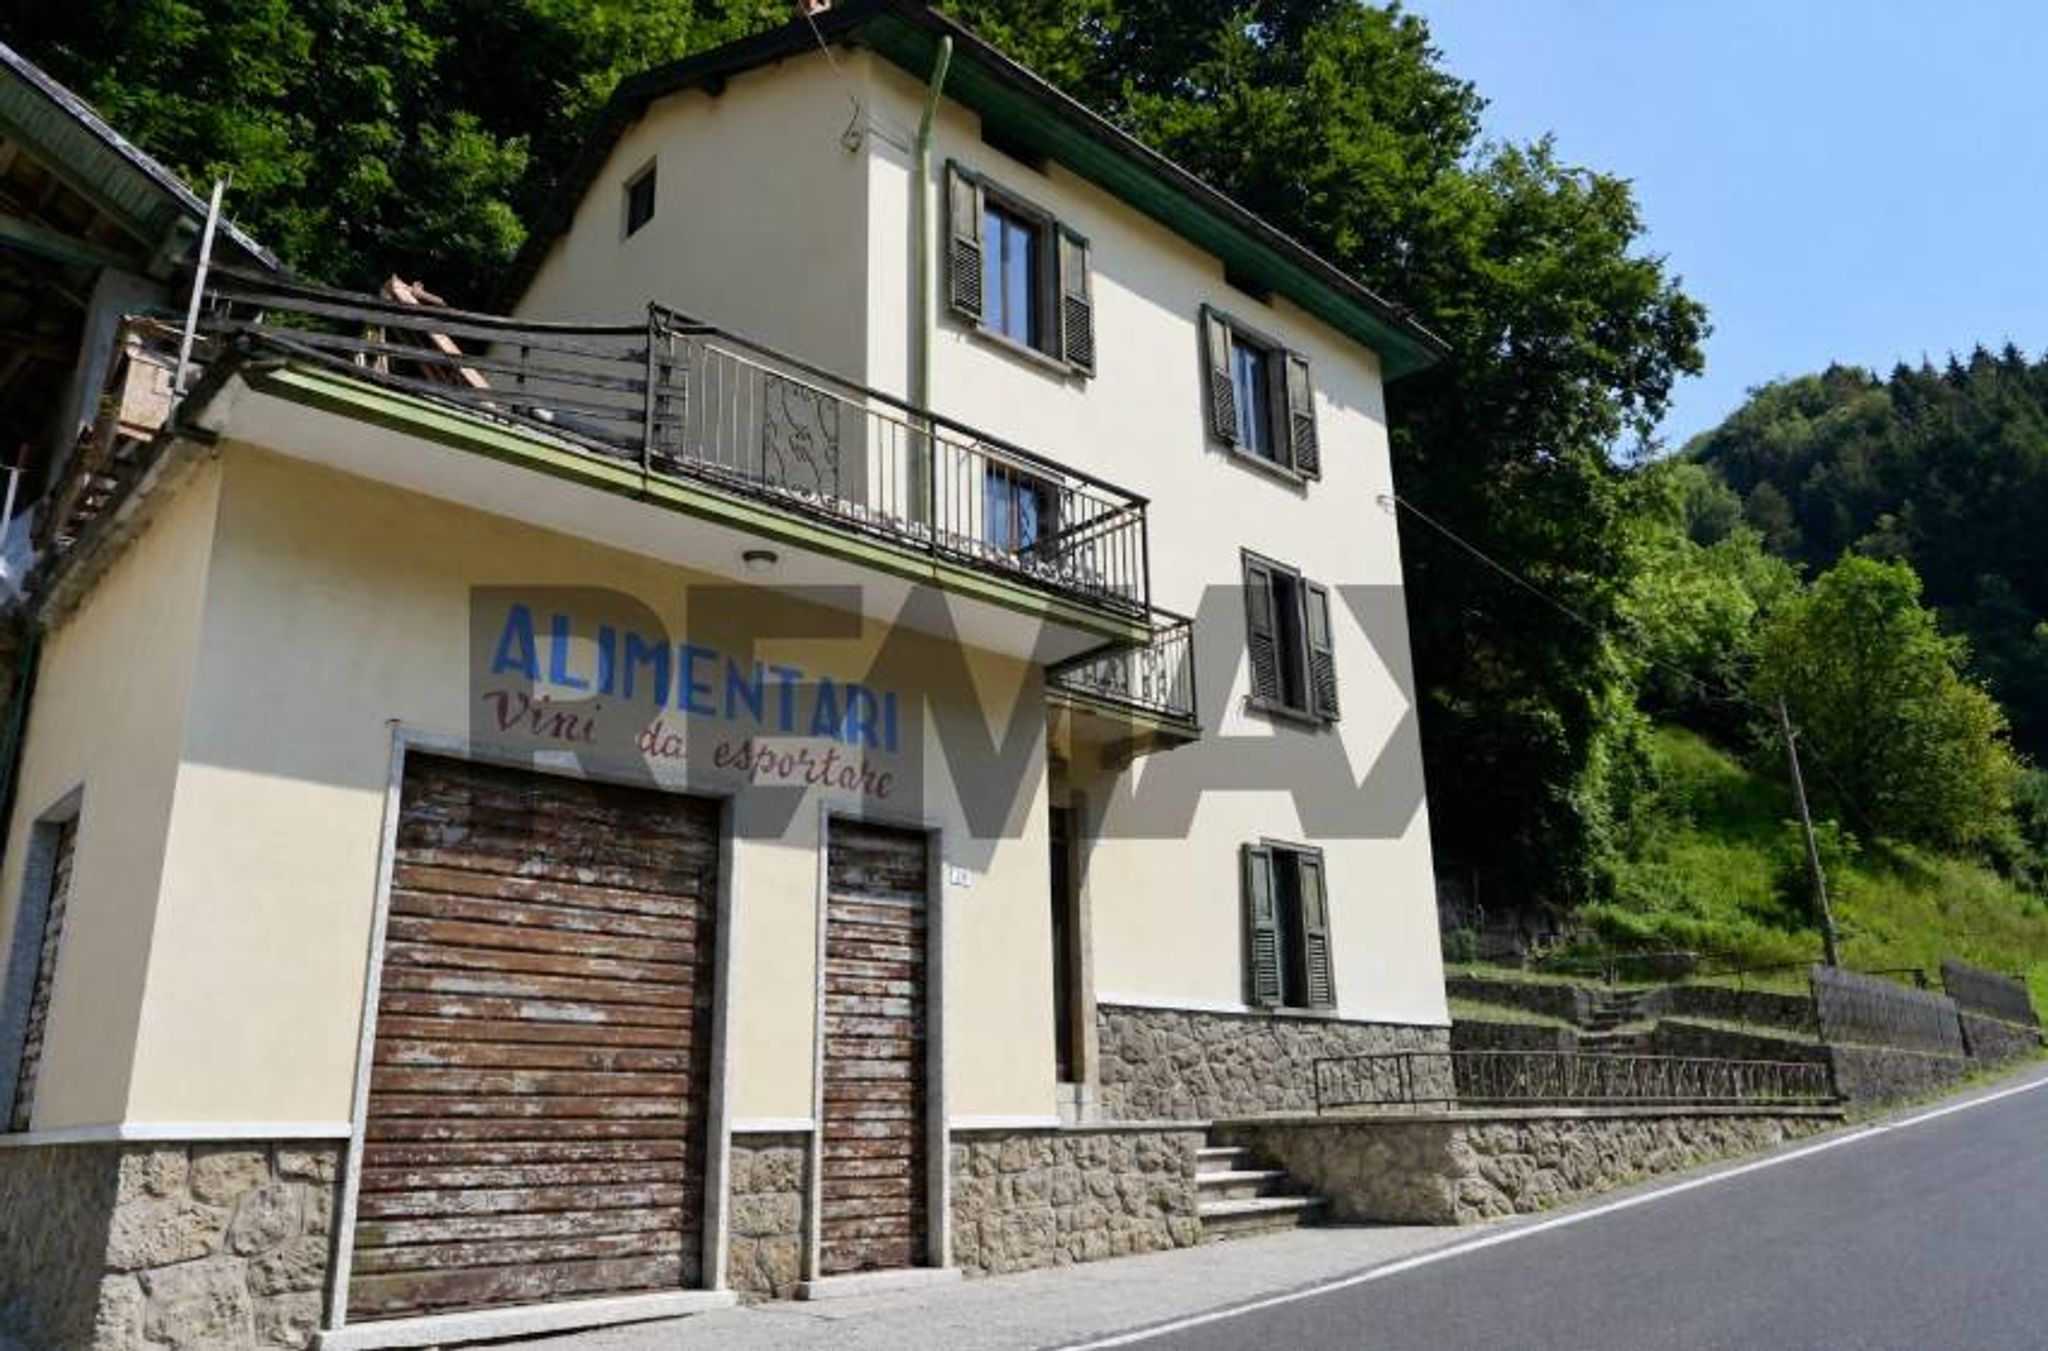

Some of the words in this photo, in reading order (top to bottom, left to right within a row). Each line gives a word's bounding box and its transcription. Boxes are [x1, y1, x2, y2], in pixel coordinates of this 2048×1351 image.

[492, 603, 897, 753] ALIMENTARI
[484, 690, 601, 744] Vini
[637, 720, 687, 757] da
[713, 737, 893, 799] esportare
